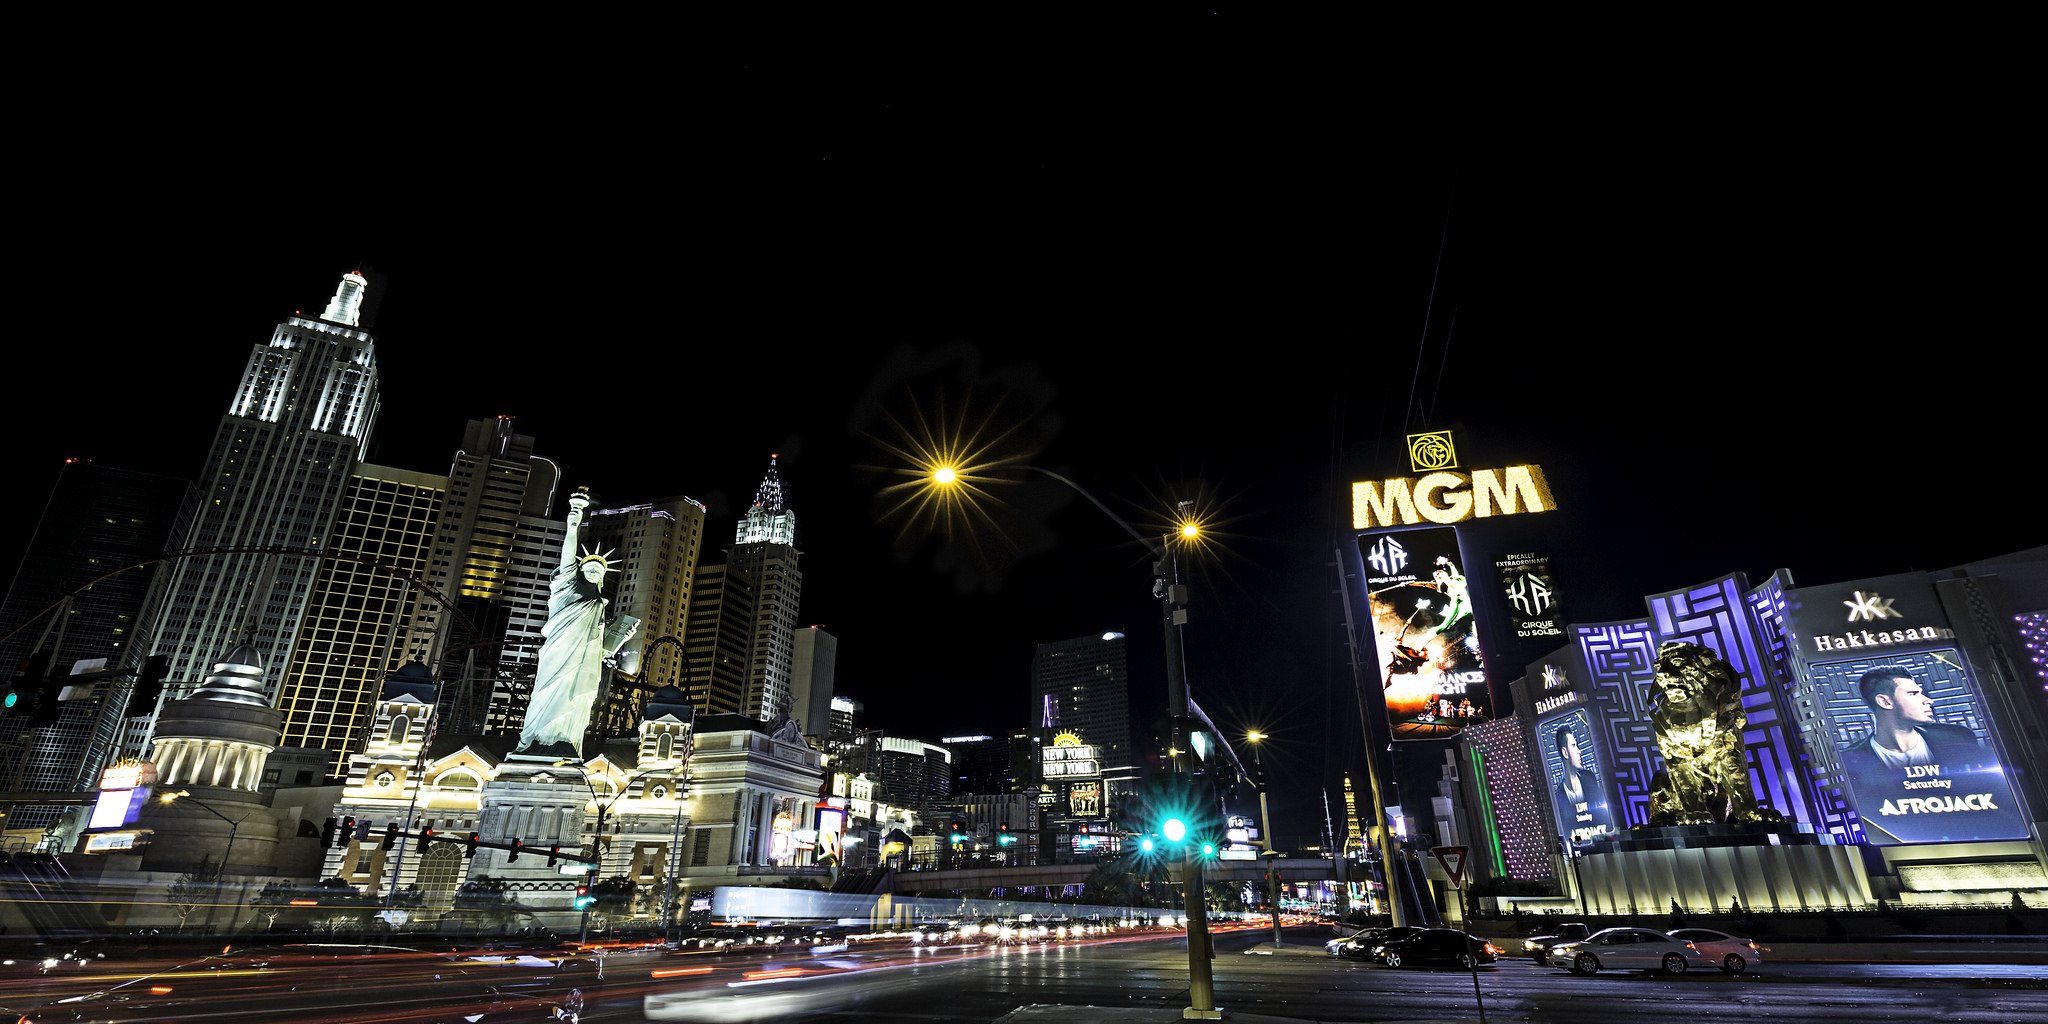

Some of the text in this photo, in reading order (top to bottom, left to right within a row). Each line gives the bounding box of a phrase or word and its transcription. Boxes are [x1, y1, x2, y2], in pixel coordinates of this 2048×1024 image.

[1352, 464, 1556, 529] MGM
[1496, 557, 1549, 567] EXTRAORDINARY
[1506, 551, 1535, 561] EPICALLY
[1521, 620, 1554, 630] CIRQUE
[1531, 628, 1562, 636] SOLEIL
[1812, 625, 1938, 652] Hakkasan
[1535, 691, 1575, 715] Hakkasan
[1043, 747, 1091, 761] NEW YORK
[1043, 761, 1092, 776] NEW YORK
[1904, 764, 1940, 778] LDW
[1903, 778, 1952, 790] Saturday
[1879, 794, 1999, 816] AFROJACK
